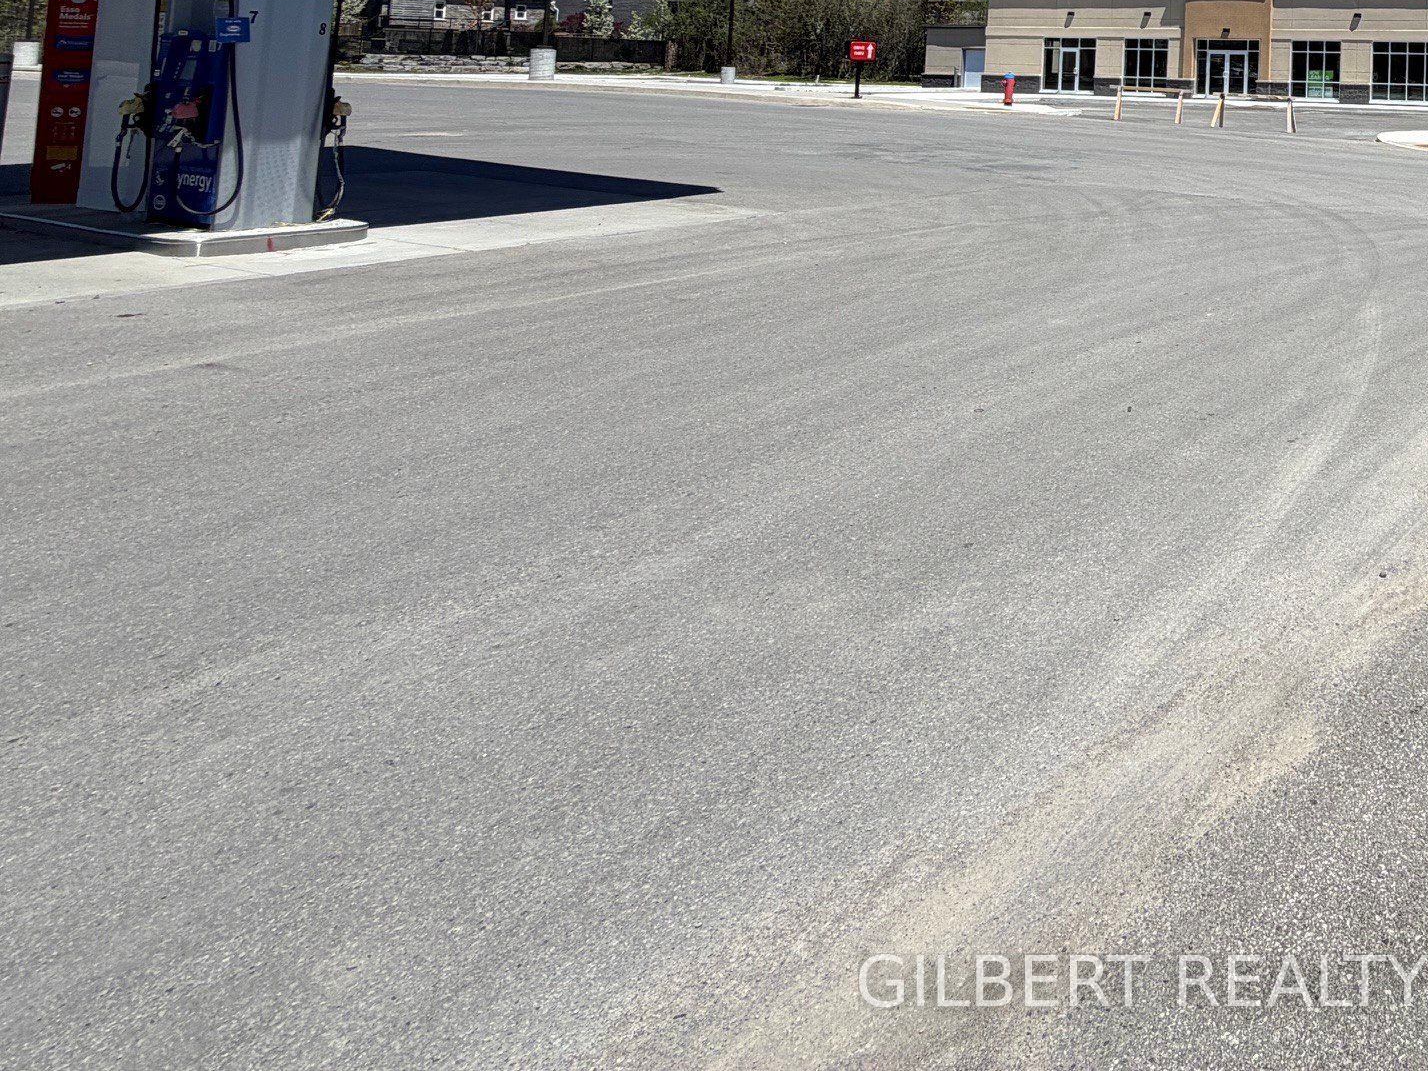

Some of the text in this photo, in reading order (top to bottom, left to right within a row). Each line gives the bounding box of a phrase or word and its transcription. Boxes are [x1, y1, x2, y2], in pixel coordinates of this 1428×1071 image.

[249, 11, 259, 23] 7
[319, 23, 327, 35] 8
[177, 173, 212, 193] ynergy
